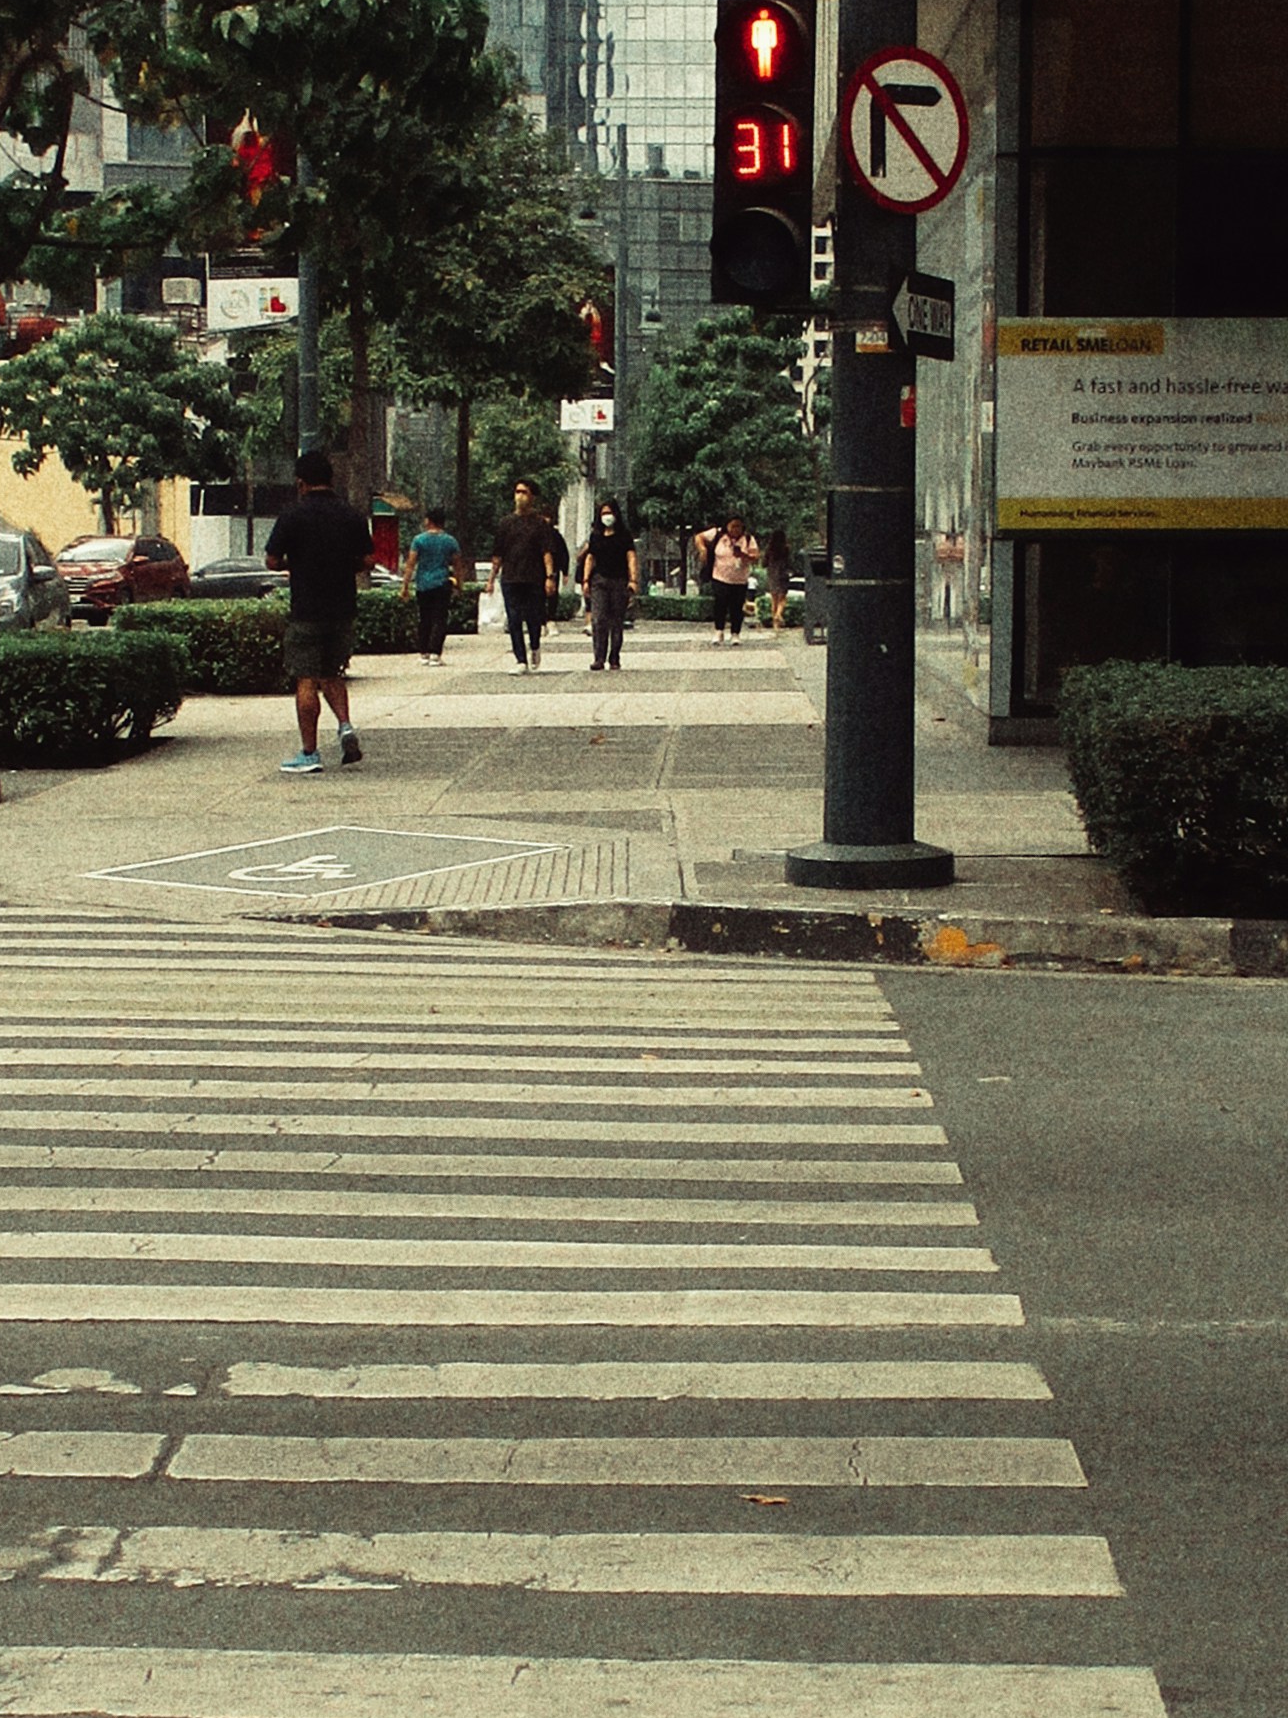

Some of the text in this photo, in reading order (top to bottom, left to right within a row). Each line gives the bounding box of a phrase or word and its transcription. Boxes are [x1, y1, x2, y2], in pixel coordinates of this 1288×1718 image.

[737, 122, 791, 175] 31
[907, 295, 951, 337] ONE WAY
[1021, 338, 1073, 352] RETAIL
[1073, 378, 1084, 392] A
[1090, 377, 1122, 393] fast
[1128, 378, 1160, 393] and
[1165, 377, 1262, 394] hassle-free
[1071, 412, 1128, 424] Business
[1131, 412, 1197, 426] expansion
[1200, 412, 1253, 424] realized
[1072, 440, 1100, 452] Grab
[1103, 442, 1136, 454] every
[1138, 441, 1209, 454] opportunity
[1212, 442, 1225, 452] to
[1227, 443, 1258, 455] grow
[1260, 442, 1283, 452] and
[1071, 458, 1124, 470] Maybank
